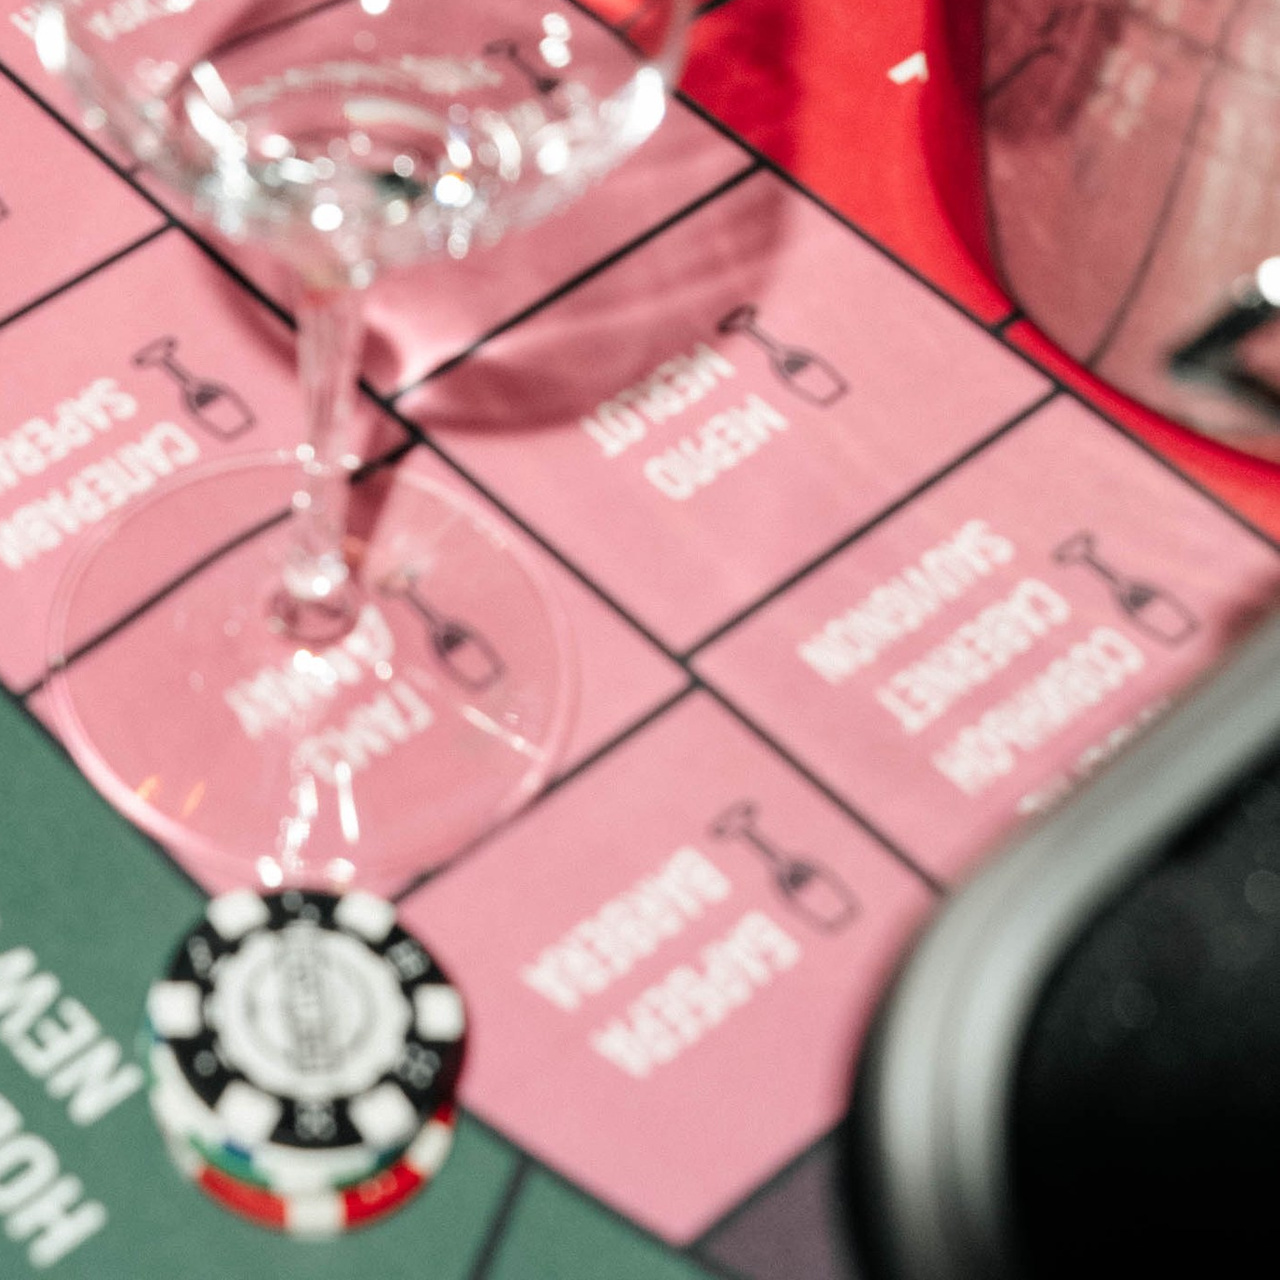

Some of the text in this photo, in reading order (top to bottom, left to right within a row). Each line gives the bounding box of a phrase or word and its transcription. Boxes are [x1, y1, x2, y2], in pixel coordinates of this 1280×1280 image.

[581, 342, 736, 459] MERLOT
[643, 393, 789, 502] МЕРЛО
[797, 517, 1015, 686] SAUVIGNON
[875, 577, 1071, 735] CABERNET
[522, 845, 733, 1015] BARBERA
[589, 910, 802, 1081] БАРБЕРА
